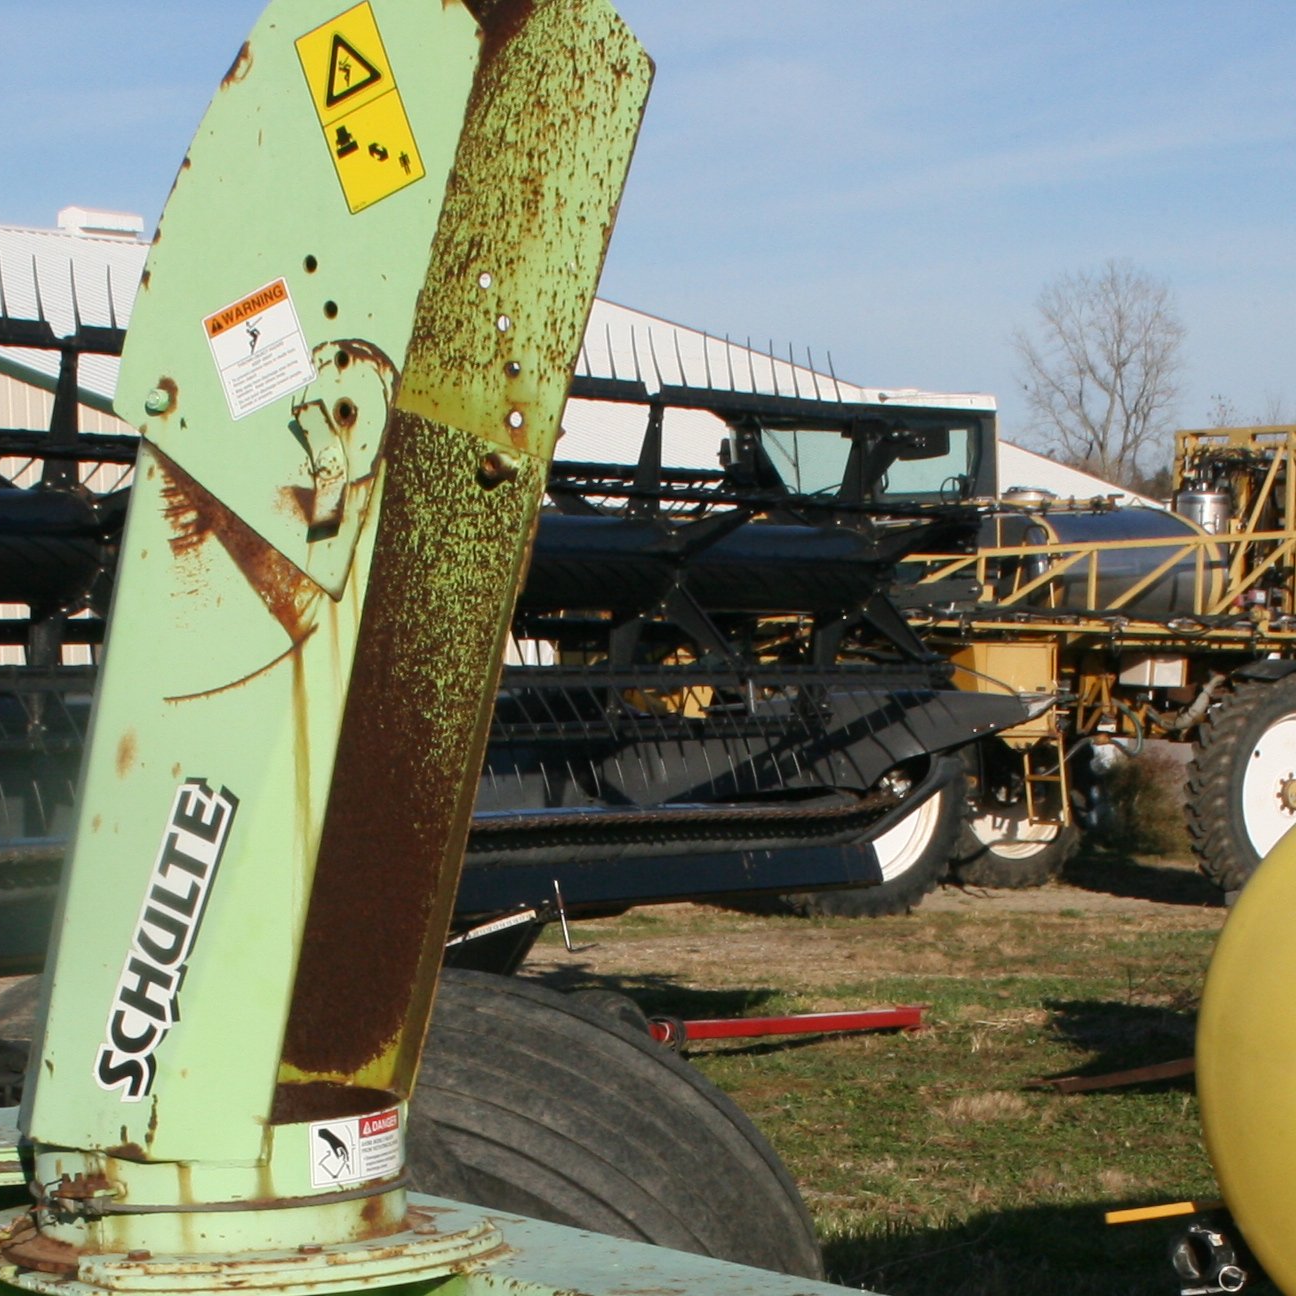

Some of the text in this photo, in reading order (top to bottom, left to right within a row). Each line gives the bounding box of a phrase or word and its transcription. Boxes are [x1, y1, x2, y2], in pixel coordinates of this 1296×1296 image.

[222, 284, 284, 325] WARNING
[97, 782, 230, 1099] SCHULTE
[371, 1115, 398, 1132] DANGER
